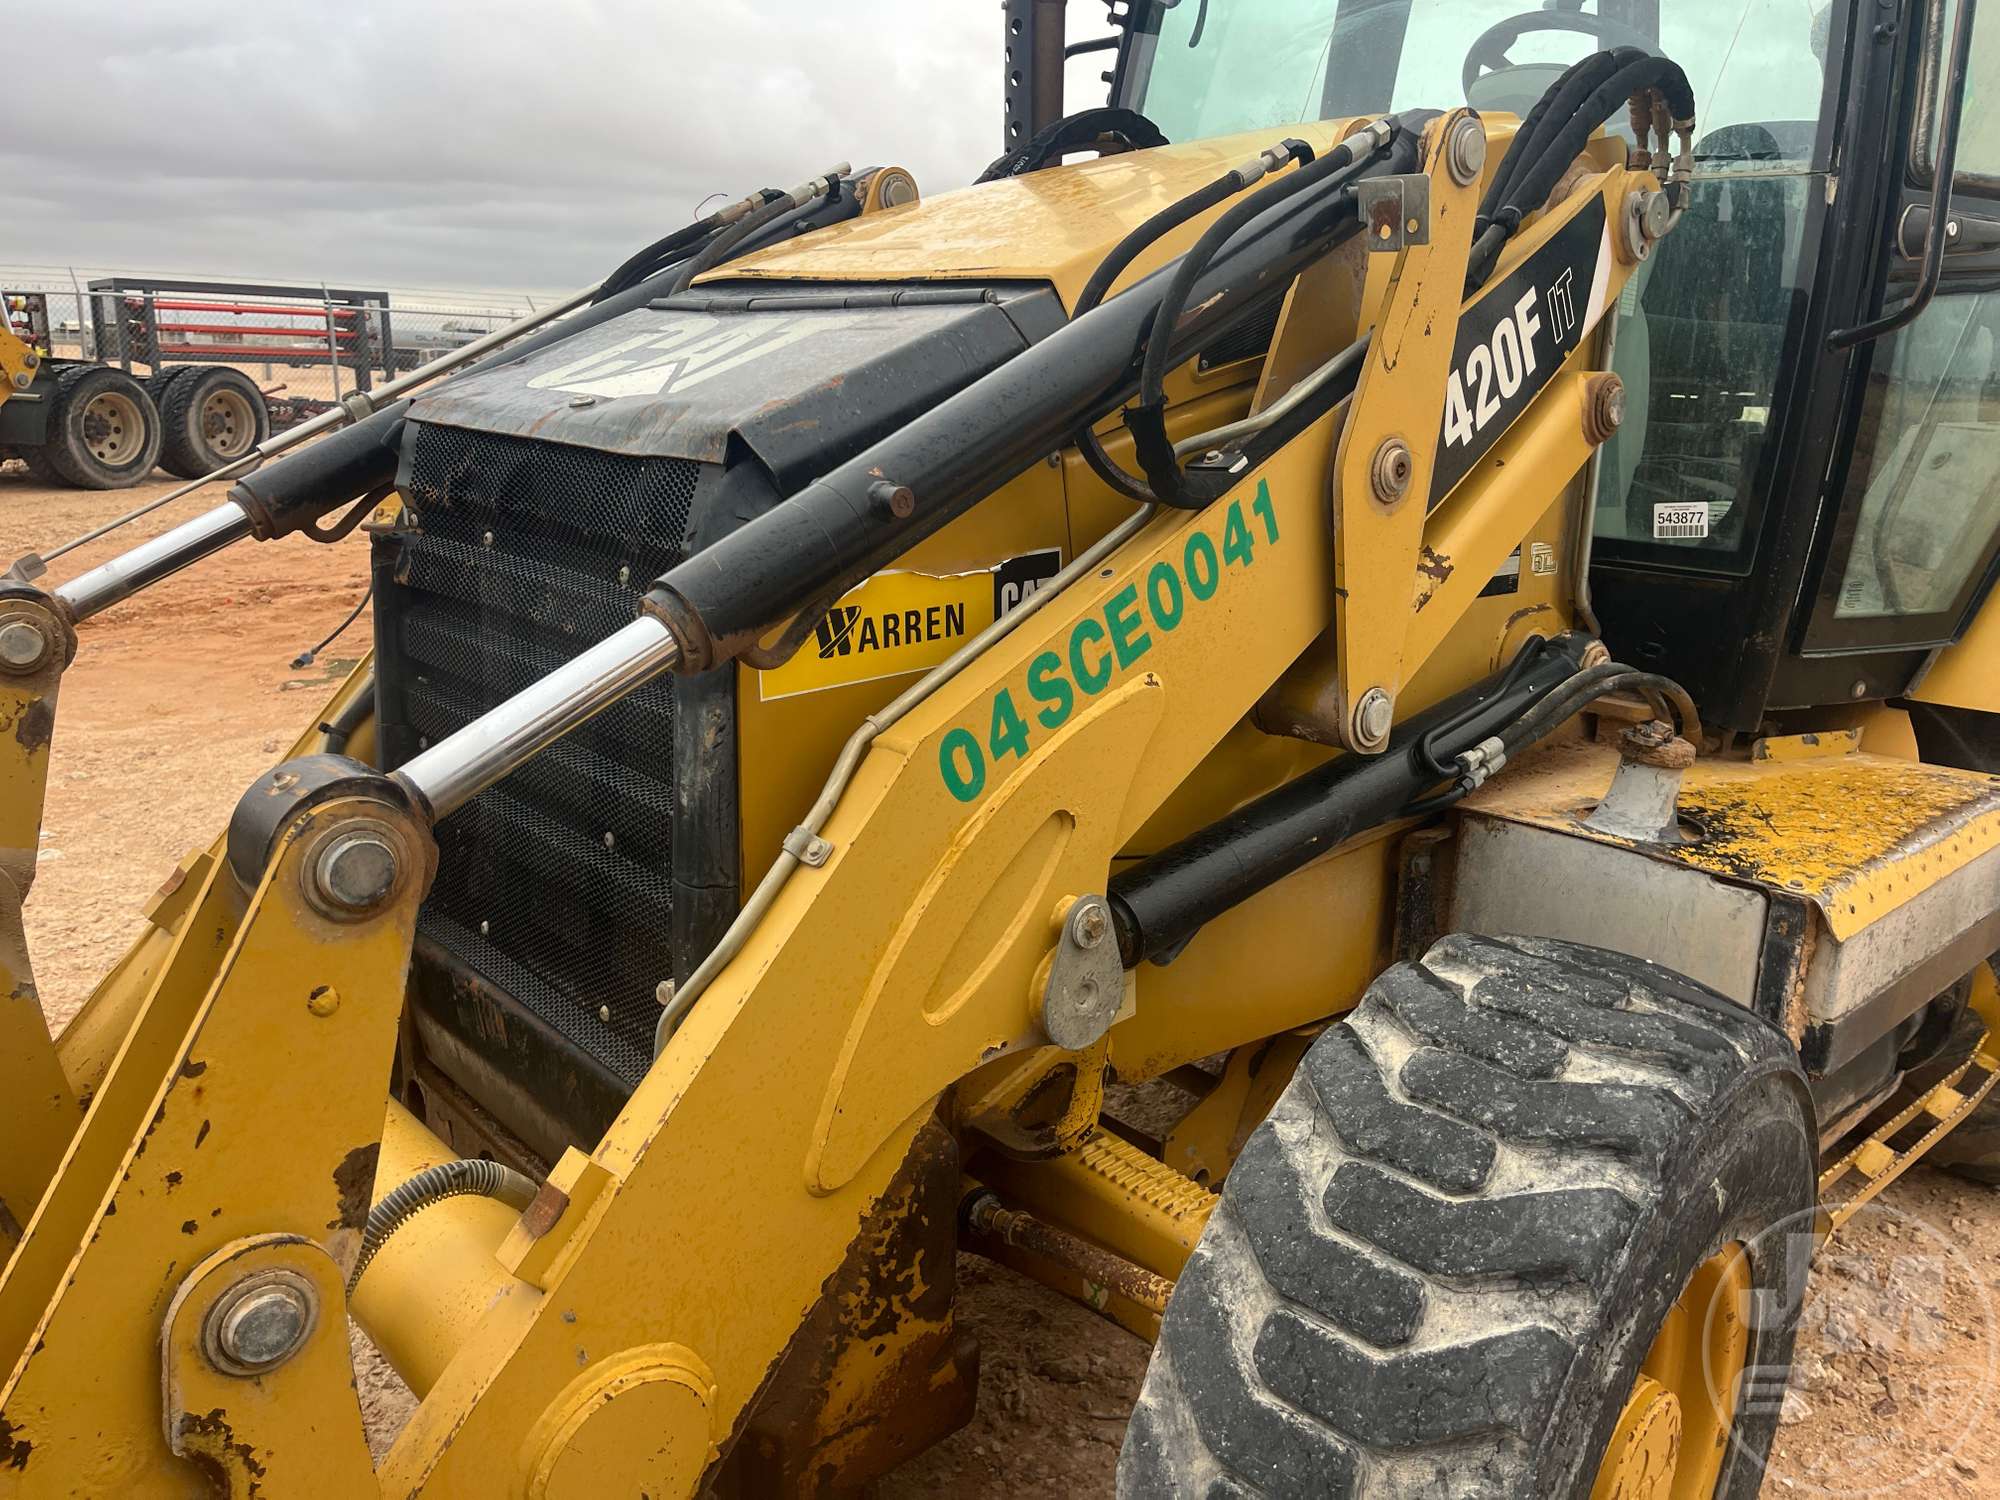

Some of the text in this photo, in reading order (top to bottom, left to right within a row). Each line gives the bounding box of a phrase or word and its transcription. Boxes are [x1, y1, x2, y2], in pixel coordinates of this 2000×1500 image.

[527, 314, 868, 398] CAT
[1444, 266, 1576, 448] 420F IT
[1657, 511, 1704, 525] 543877
[815, 577, 1054, 659] WARREN CA
[939, 477, 1280, 802] 04SCE0041
